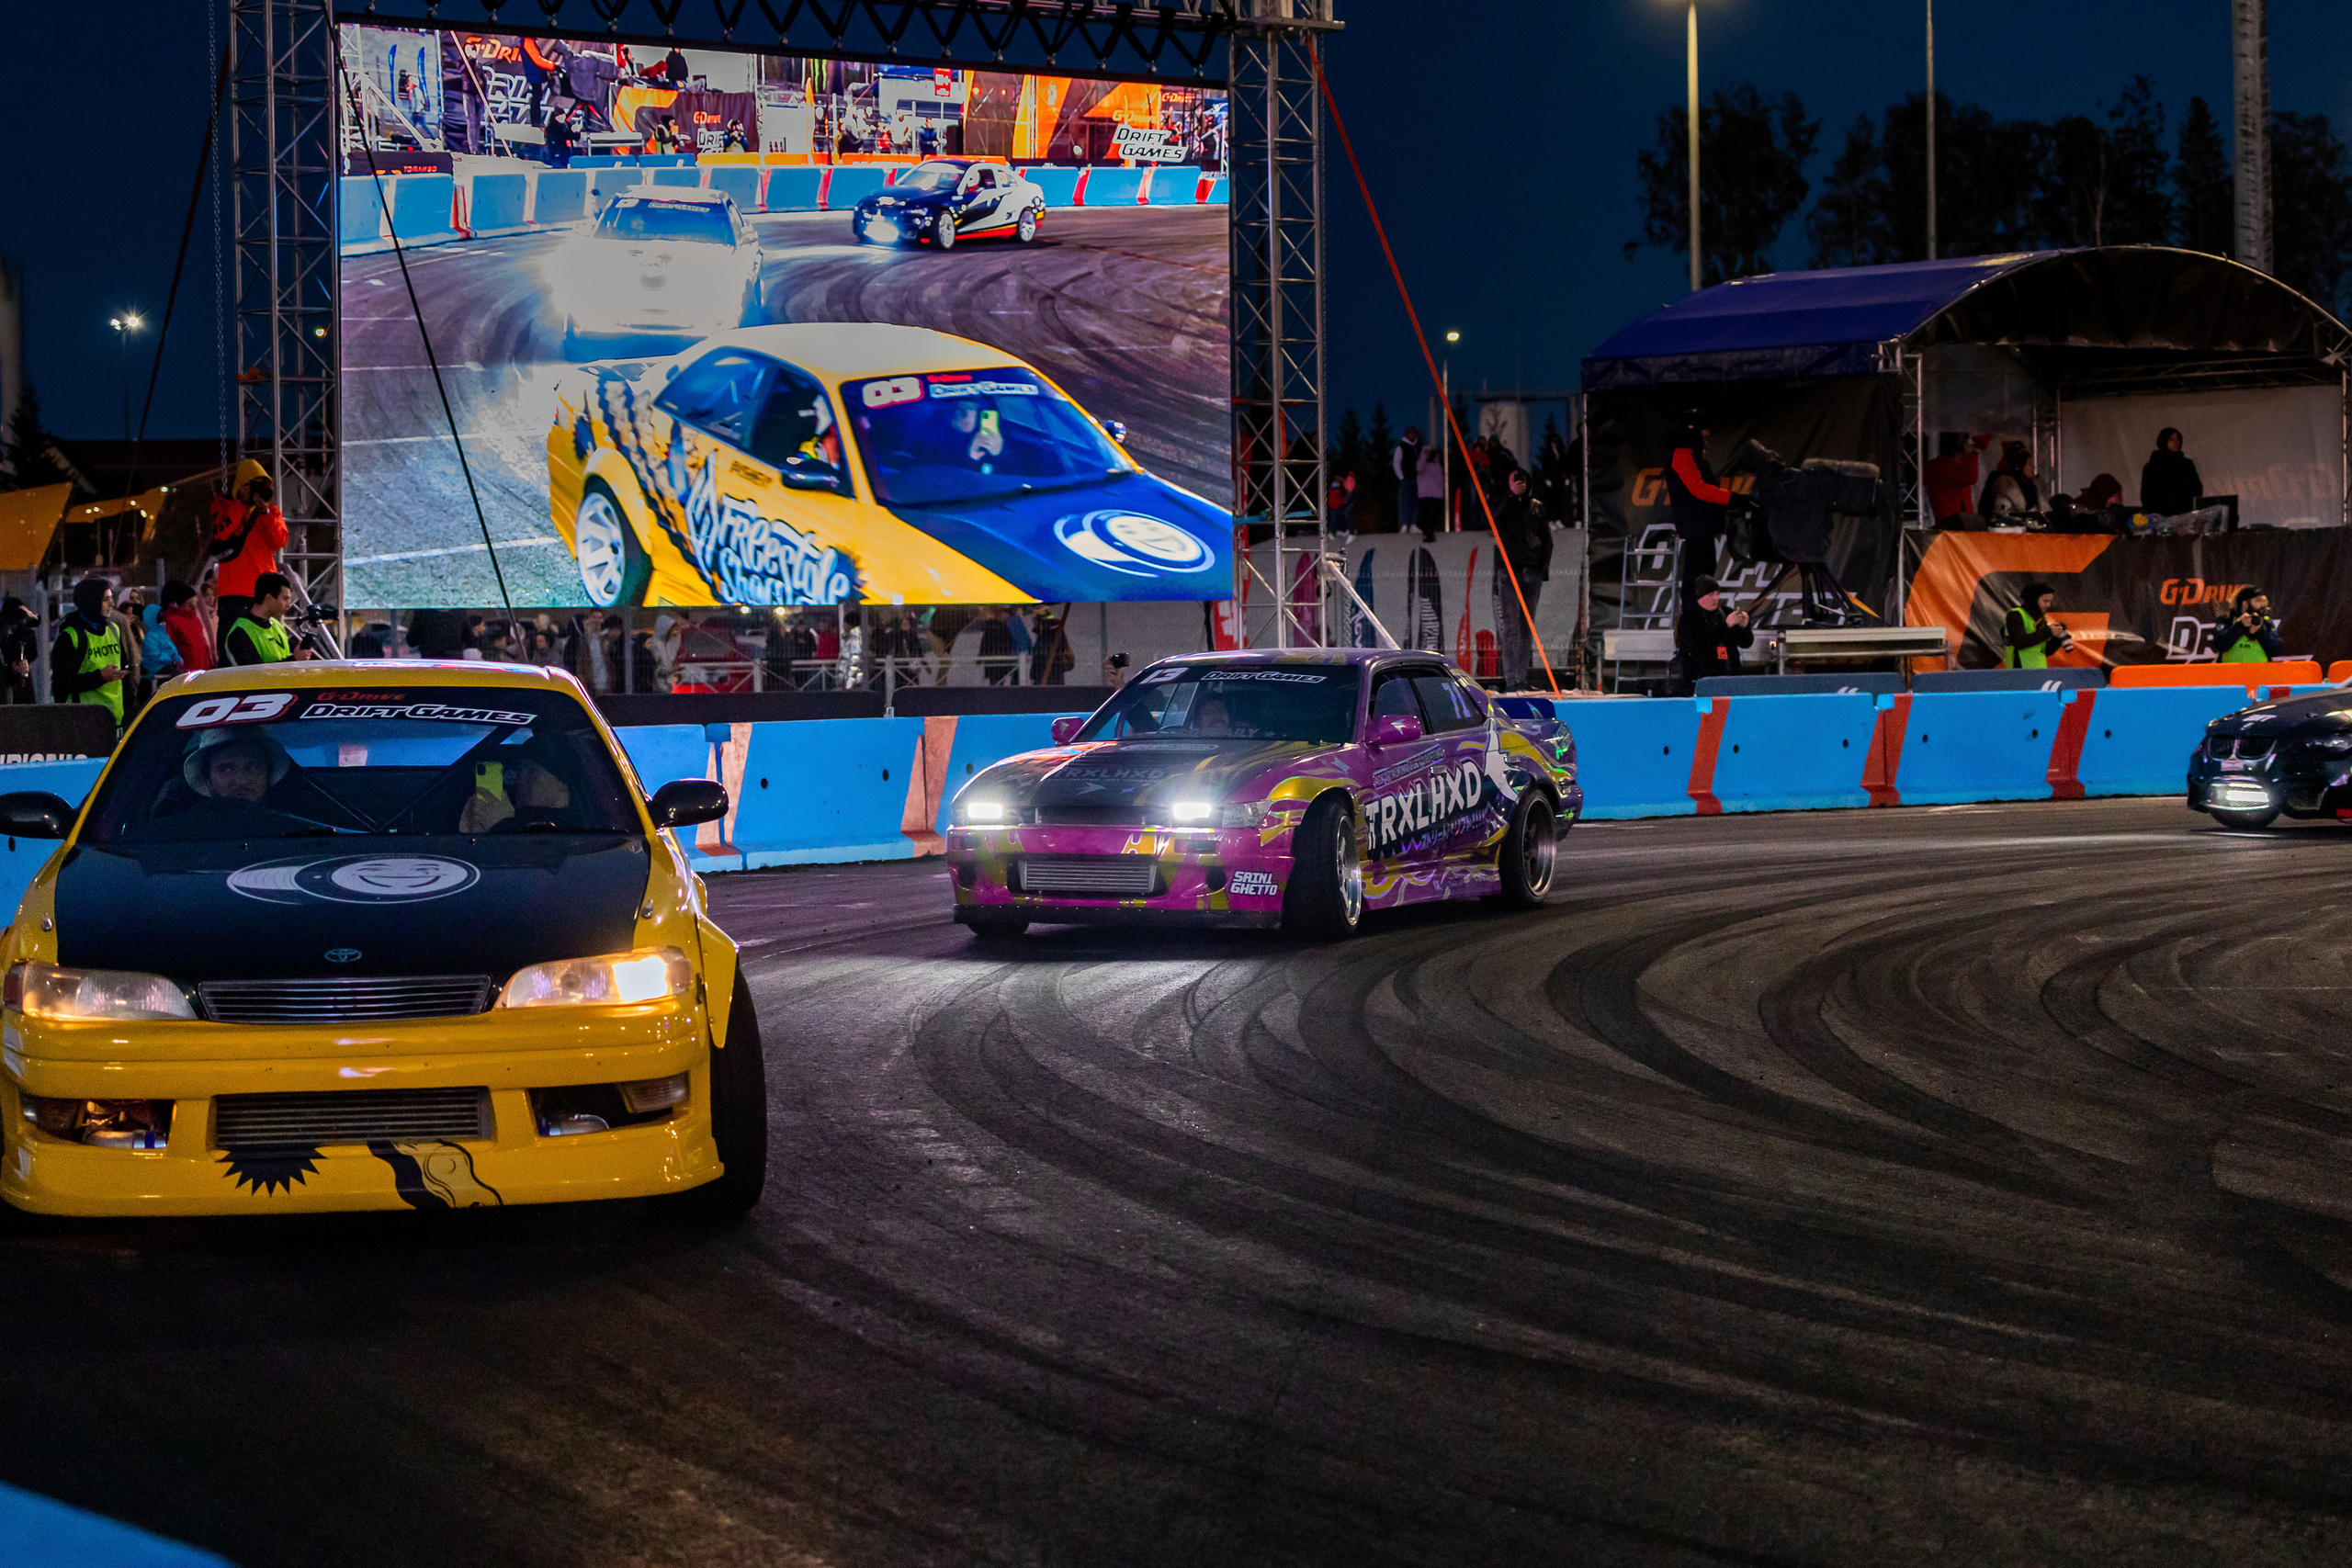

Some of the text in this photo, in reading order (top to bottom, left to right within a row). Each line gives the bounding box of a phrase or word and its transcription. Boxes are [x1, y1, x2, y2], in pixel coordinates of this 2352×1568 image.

[1116, 128, 1167, 142] DRIFT
[1122, 143, 1182, 159] GAMES
[862, 377, 924, 408] 03
[87, 643, 119, 660] PHOTO
[1139, 667, 1328, 685] 13 DRIFT GAMES
[175, 693, 296, 728] 03
[301, 704, 538, 725] DRIFT GAMES
[1229, 882, 1278, 897] GHETTO
